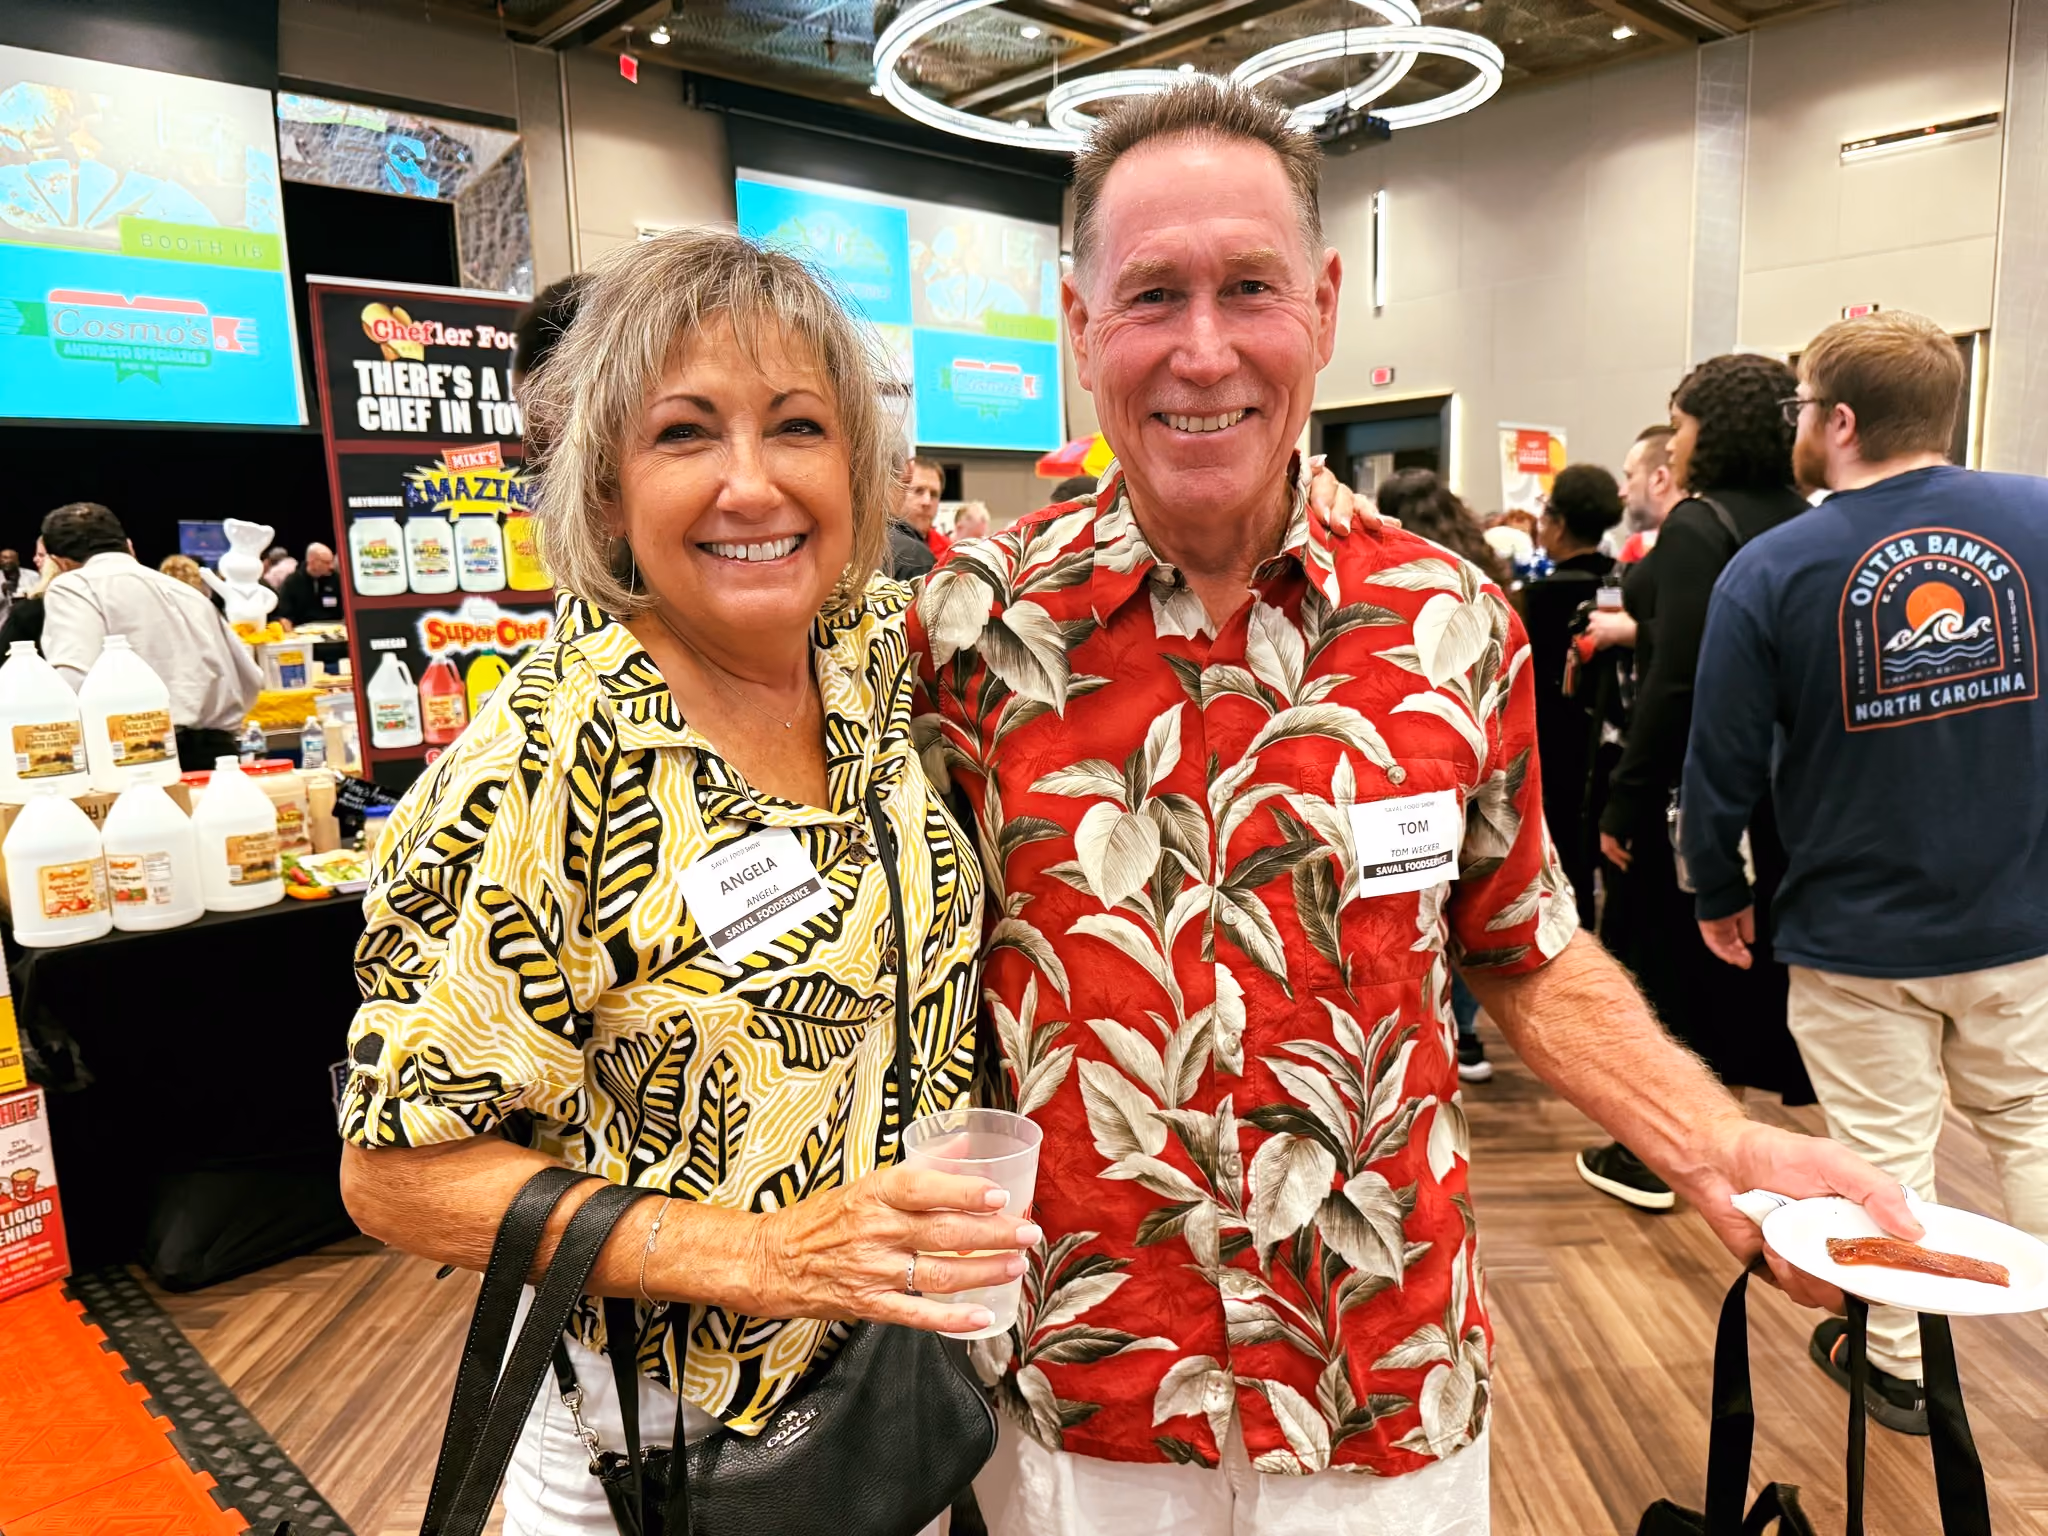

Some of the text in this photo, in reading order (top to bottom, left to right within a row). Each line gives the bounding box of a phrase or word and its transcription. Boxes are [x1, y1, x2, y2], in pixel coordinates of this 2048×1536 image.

[140, 233, 222, 256] BOOTH
[53, 308, 209, 346] Cosmo's
[372, 319, 474, 348] Chefler
[352, 359, 474, 400] THERE'S
[480, 366, 502, 401] A
[356, 396, 432, 433] CHEF
[439, 400, 473, 434] IN
[451, 450, 498, 469] MIKE'S
[1850, 534, 2011, 607] OUTER BANKS
[1881, 561, 1982, 604] EAST COAST
[1855, 693, 1922, 721] NORTH
[1929, 671, 2027, 708] CAROLINA
[1397, 819, 1429, 836] TOM
[1375, 855, 1448, 876] SAVAL FOODSERVICE
[1391, 843, 1440, 858] TOM WECKER
[720, 856, 778, 896] ANGELA
[724, 885, 811, 940] SAVAL FOODSERVICE
[746, 884, 780, 909] ANGELA
[0, 1199, 53, 1230] LIQUID
[766, 1408, 820, 1448] COACH
